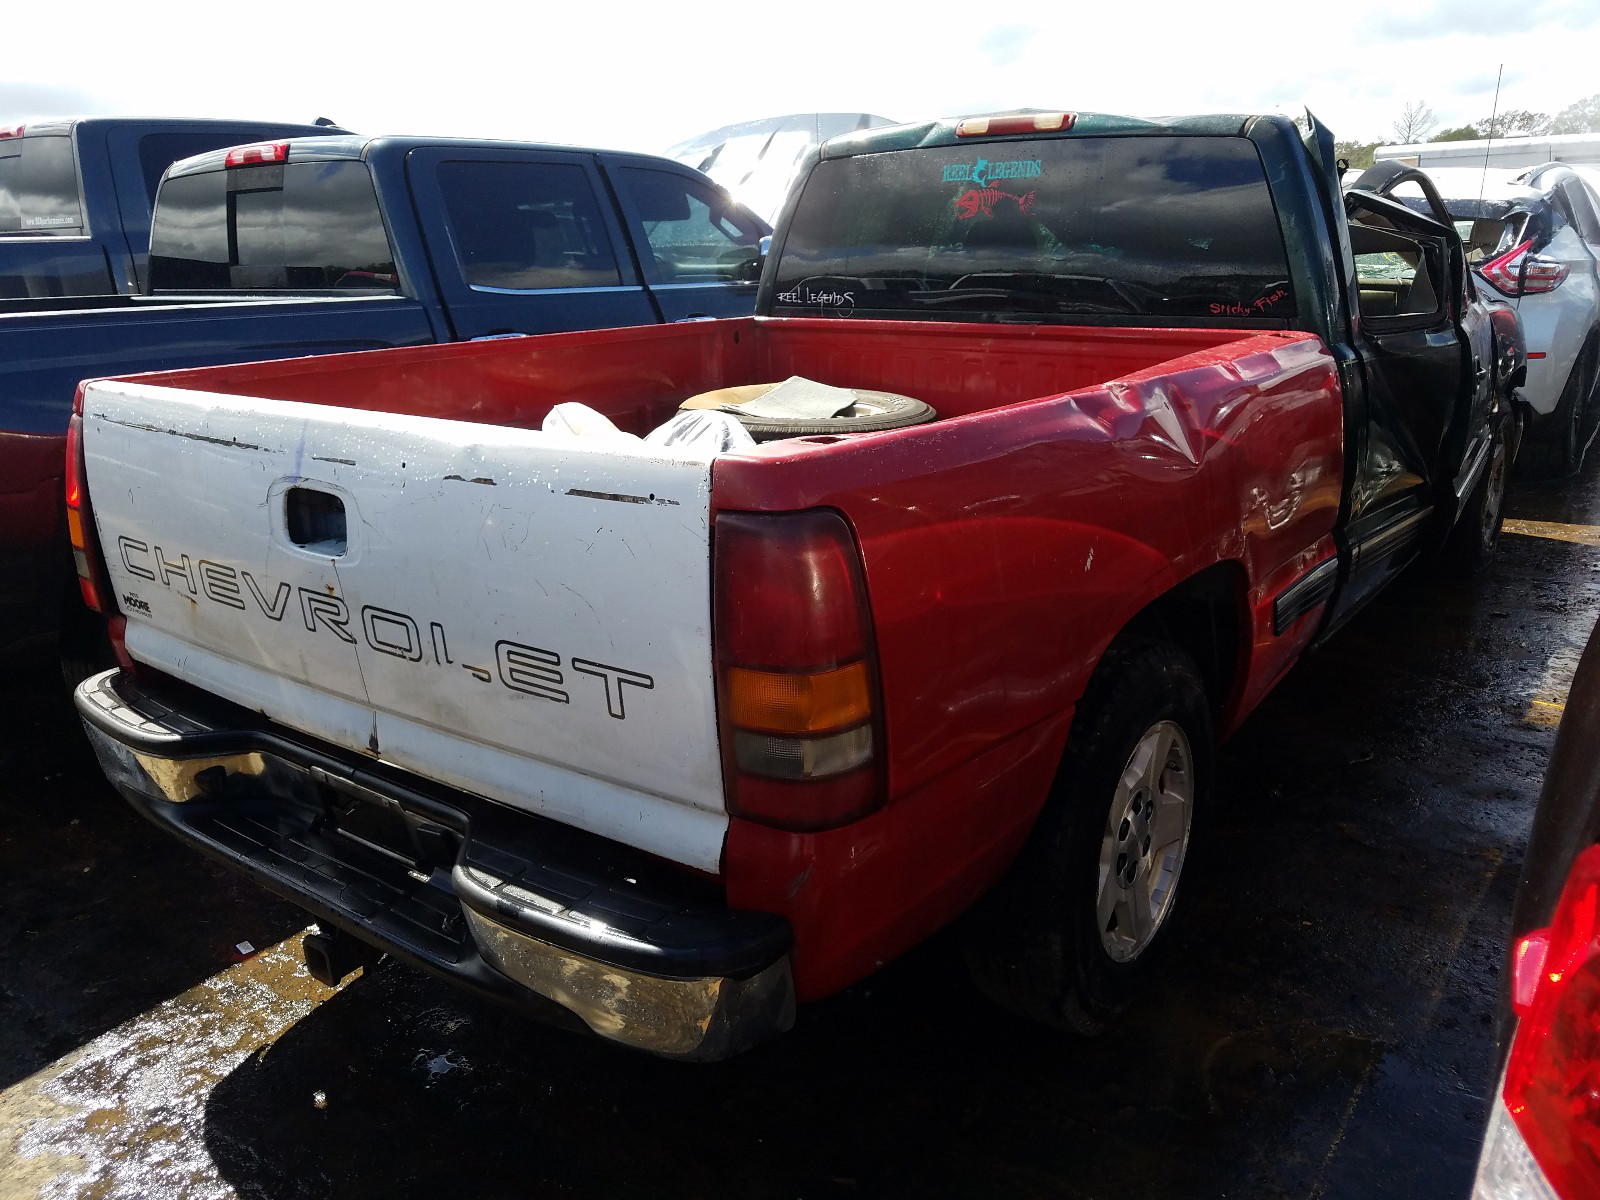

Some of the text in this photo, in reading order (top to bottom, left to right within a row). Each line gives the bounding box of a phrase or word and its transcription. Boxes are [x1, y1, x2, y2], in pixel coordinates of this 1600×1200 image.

[943, 159, 1041, 182] REEL LEGENDS
[122, 593, 151, 613] MOORE
